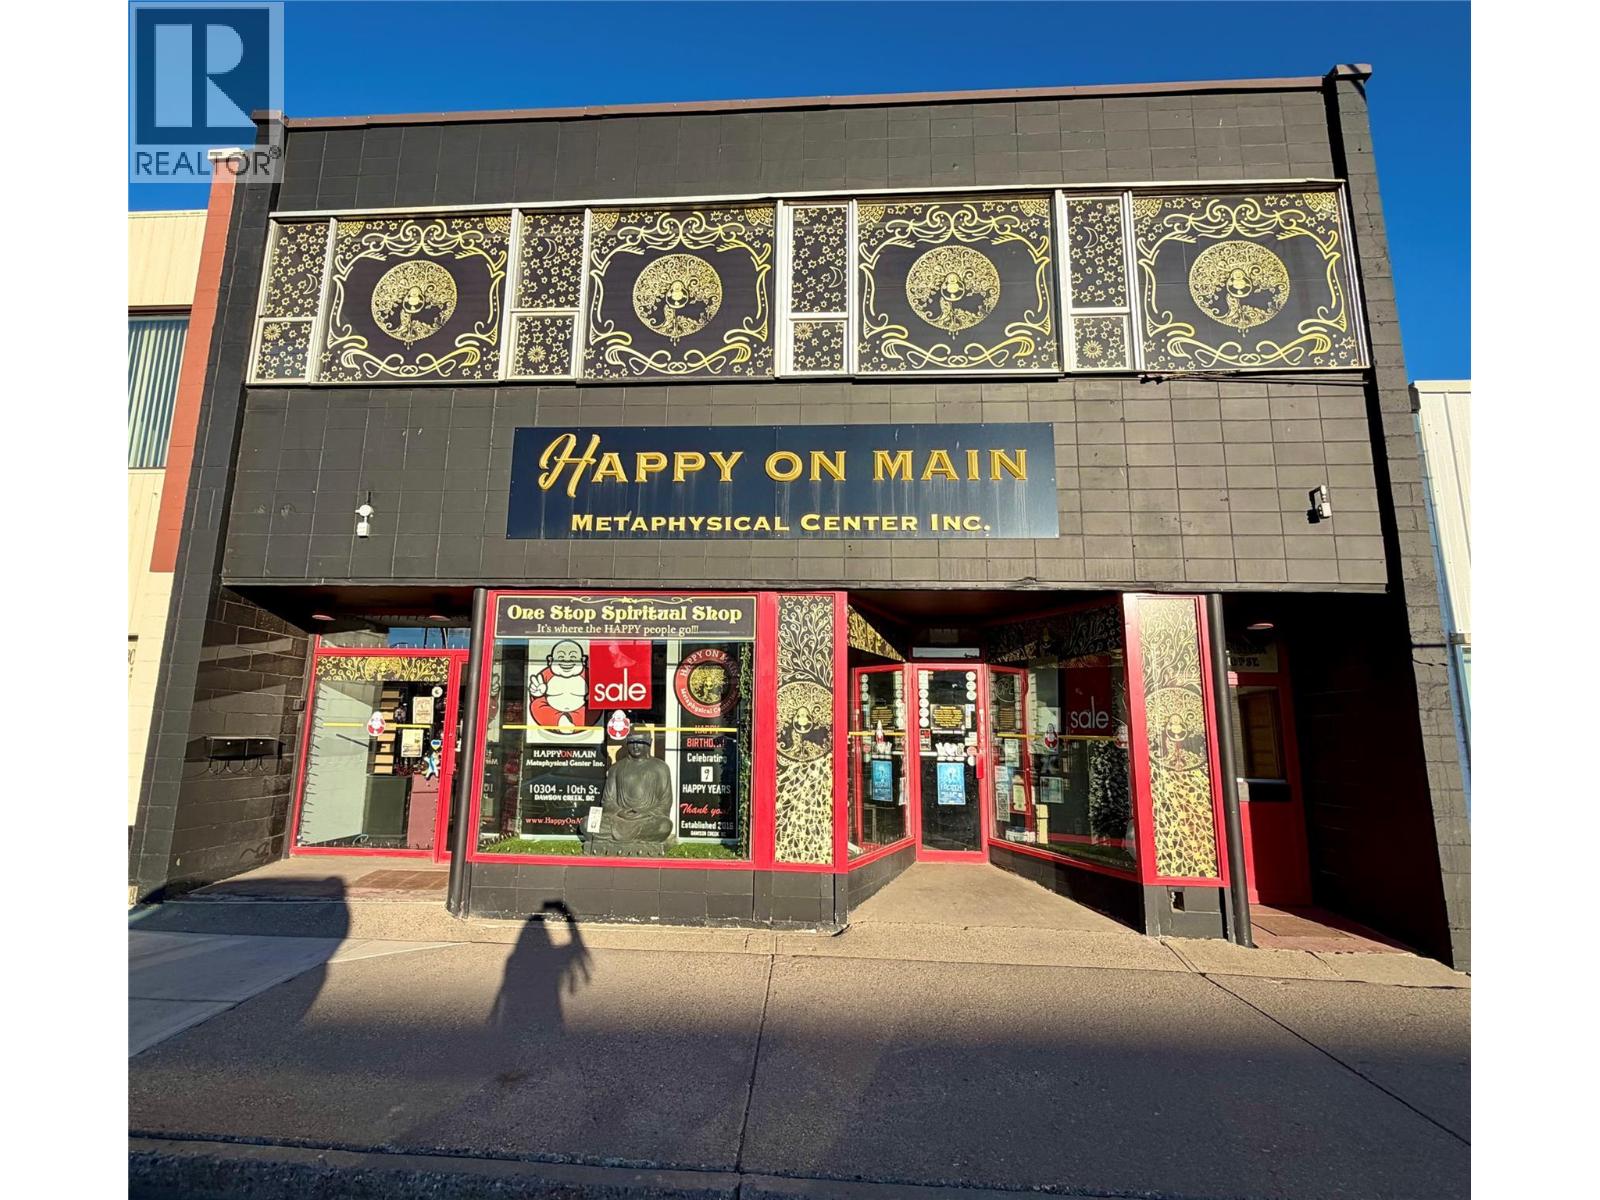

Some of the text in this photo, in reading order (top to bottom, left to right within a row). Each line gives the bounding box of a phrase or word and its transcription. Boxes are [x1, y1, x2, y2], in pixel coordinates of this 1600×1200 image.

[538, 433, 1028, 498] HAPPY ON MAIN
[571, 512, 991, 532] METAPHYSICAL CENTER INC.
[507, 604, 743, 625] One Stop Spiritual Shop
[537, 624, 699, 637] It's where the HAPPY people go!!!
[680, 651, 703, 677] HAPPY
[705, 649, 720, 658] ON
[593, 667, 647, 702] sale
[1070, 695, 1109, 729] sale
[525, 759, 569, 768] Metaphysical
[569, 759, 592, 767] Center
[529, 784, 557, 794] 10304
[566, 784, 587, 795] 10th
[588, 784, 601, 795] St.
[682, 783, 731, 795] HAPPY YEARS
[585, 794, 596, 802] BC
[681, 803, 709, 815] Thank
[681, 820, 717, 830] Established
